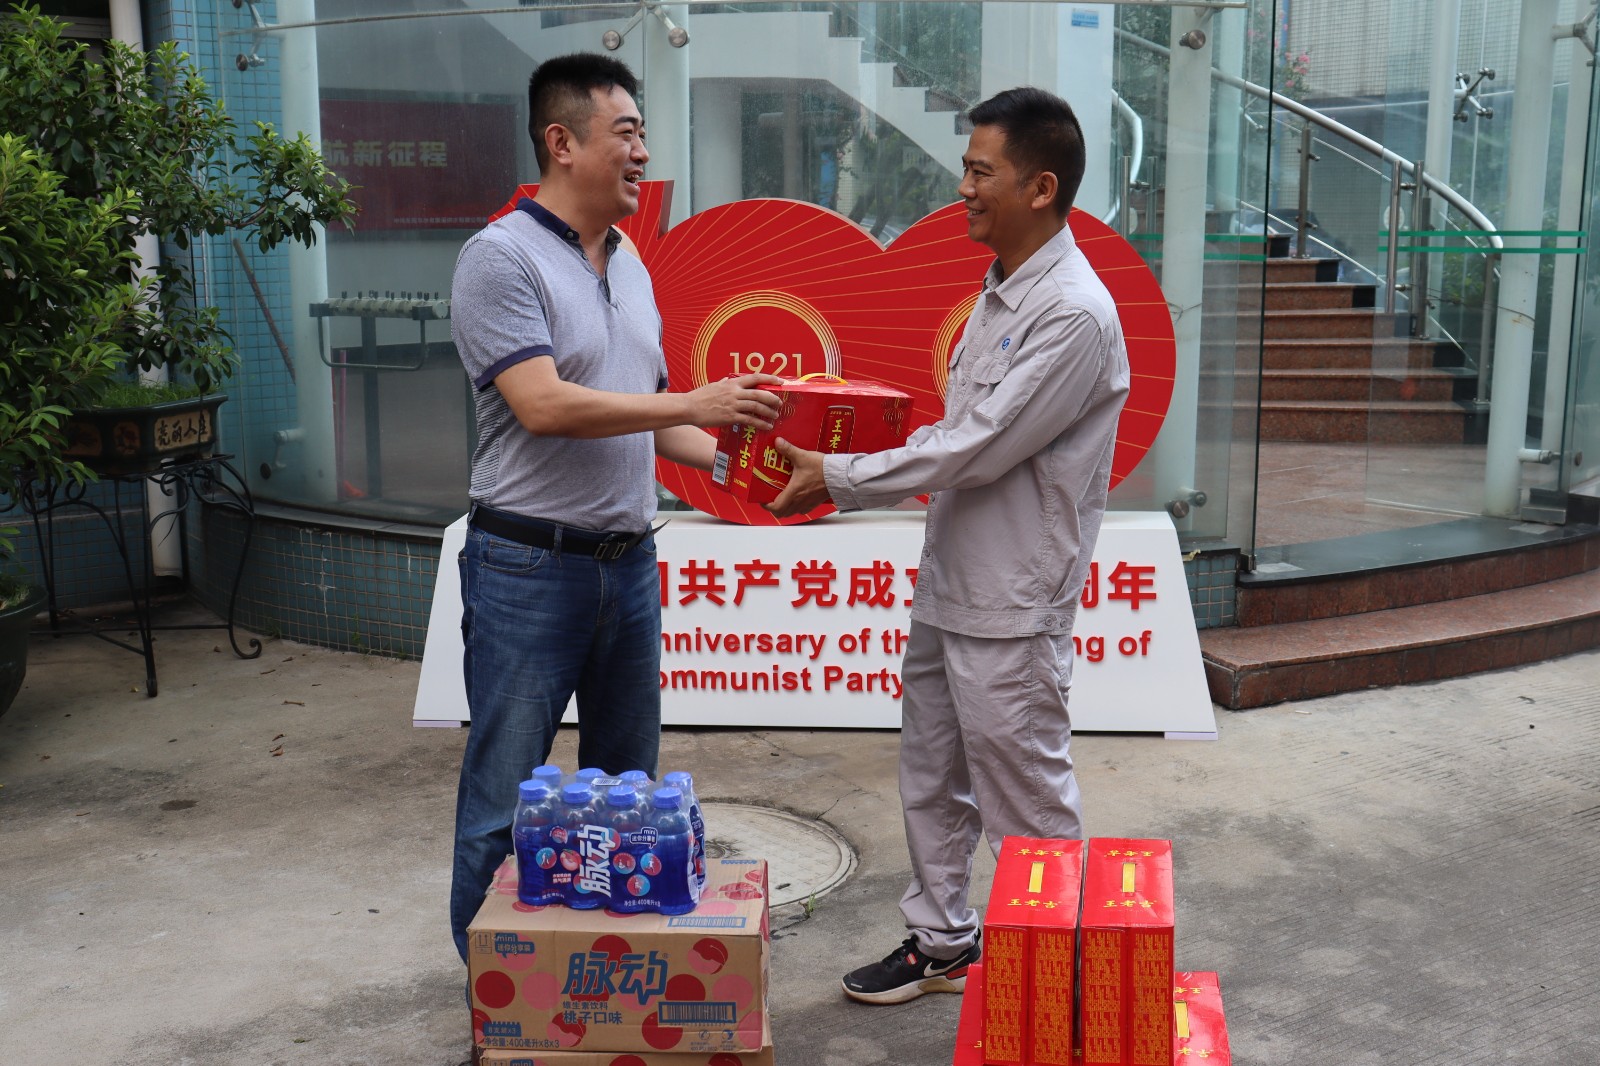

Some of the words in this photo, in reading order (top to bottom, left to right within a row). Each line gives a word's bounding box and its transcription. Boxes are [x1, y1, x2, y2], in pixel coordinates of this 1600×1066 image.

[729, 352, 802, 378] 1921
[828, 418, 844, 454] 王老
[838, 627, 871, 654] of
[1118, 630, 1152, 656] of
[823, 665, 903, 699] Party
[577, 824, 616, 898] 脉动
[1007, 898, 1059, 908] 王老吉
[1103, 899, 1155, 908] 王老吉
[561, 950, 669, 1005] 脉动
[563, 1011, 623, 1025] 桃子口味
